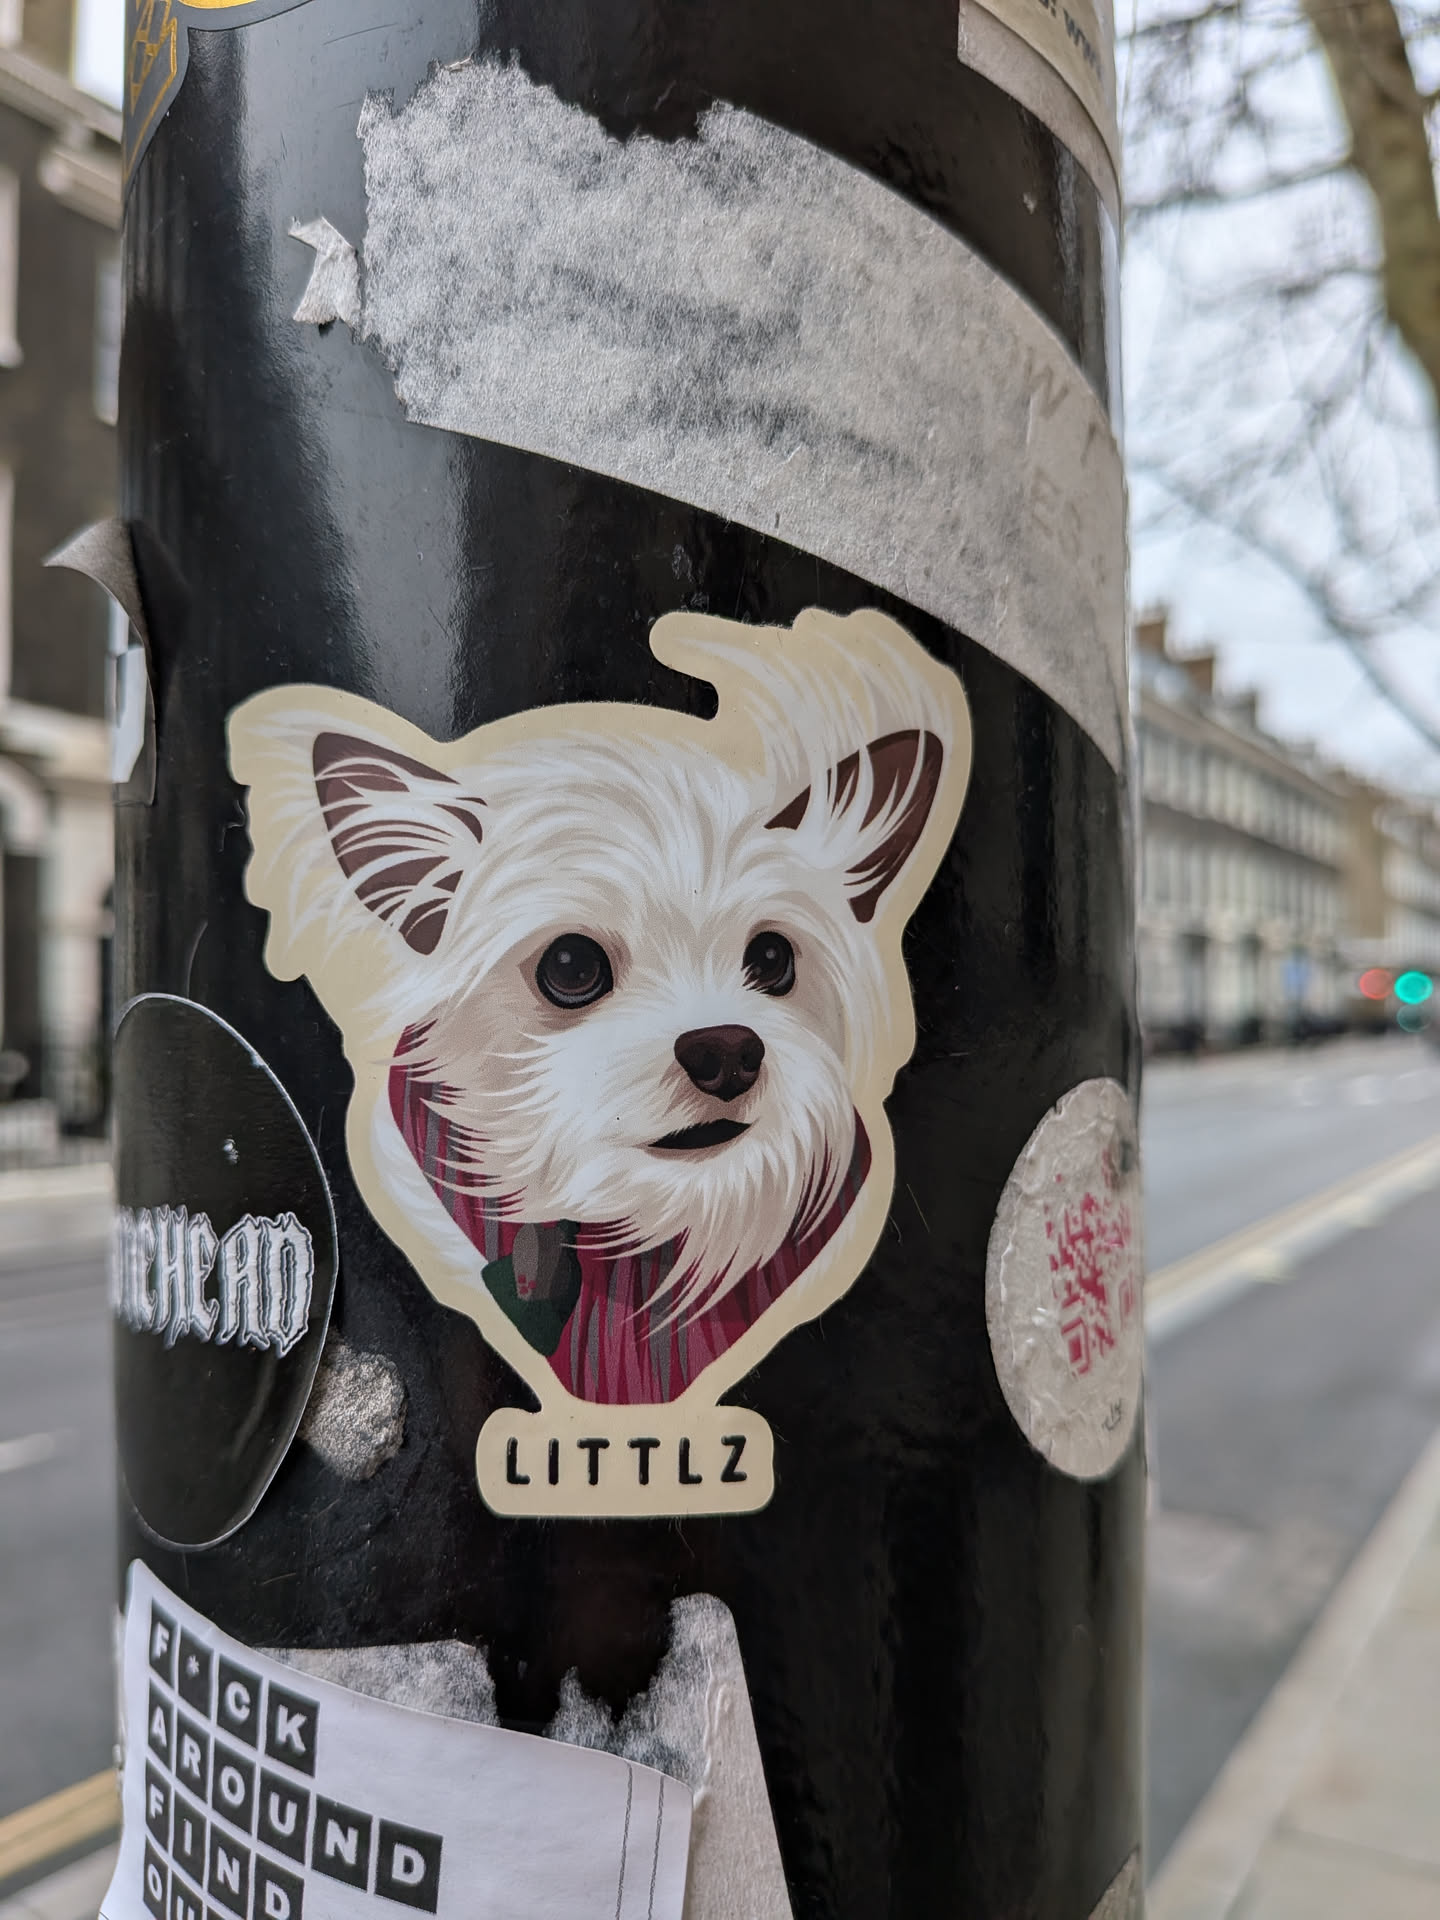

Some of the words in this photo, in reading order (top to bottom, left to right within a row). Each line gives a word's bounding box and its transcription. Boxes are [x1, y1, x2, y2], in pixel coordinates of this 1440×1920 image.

[506, 1435, 748, 1486] LITTLZ
[149, 1787, 292, 1920] FIND
[151, 1704, 427, 1887] AROUND
